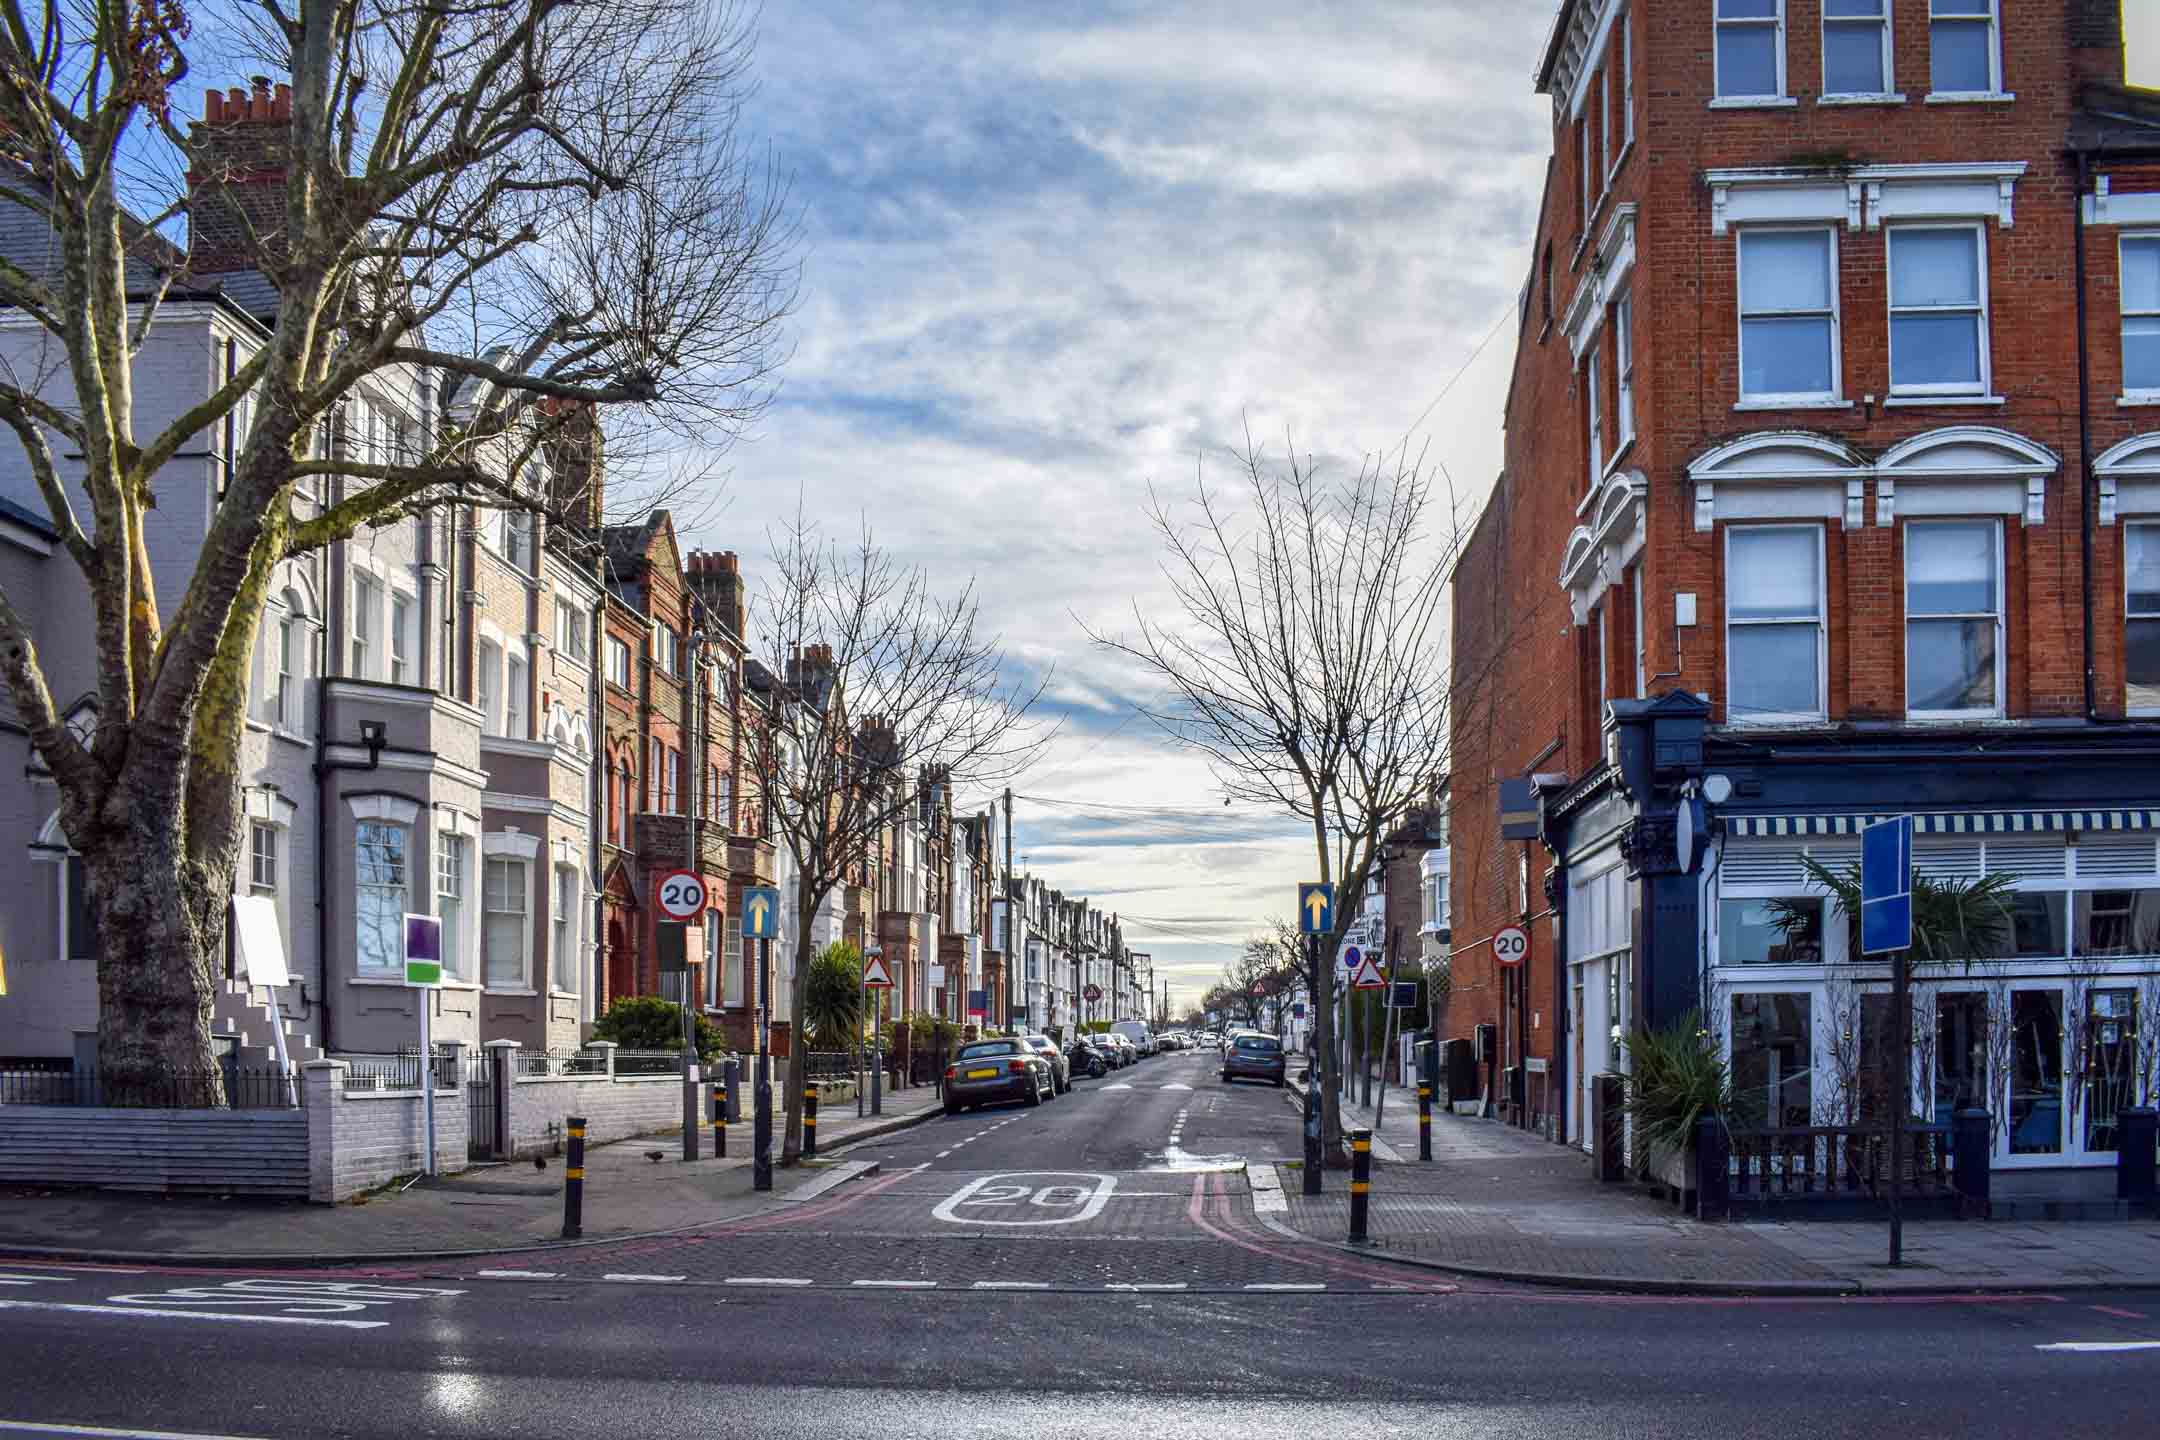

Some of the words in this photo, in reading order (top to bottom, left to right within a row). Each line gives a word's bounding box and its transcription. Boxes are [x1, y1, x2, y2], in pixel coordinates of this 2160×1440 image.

[664, 884, 701, 906] 20
[1497, 936, 1525, 954] 20
[962, 1185, 1092, 1207] 20
